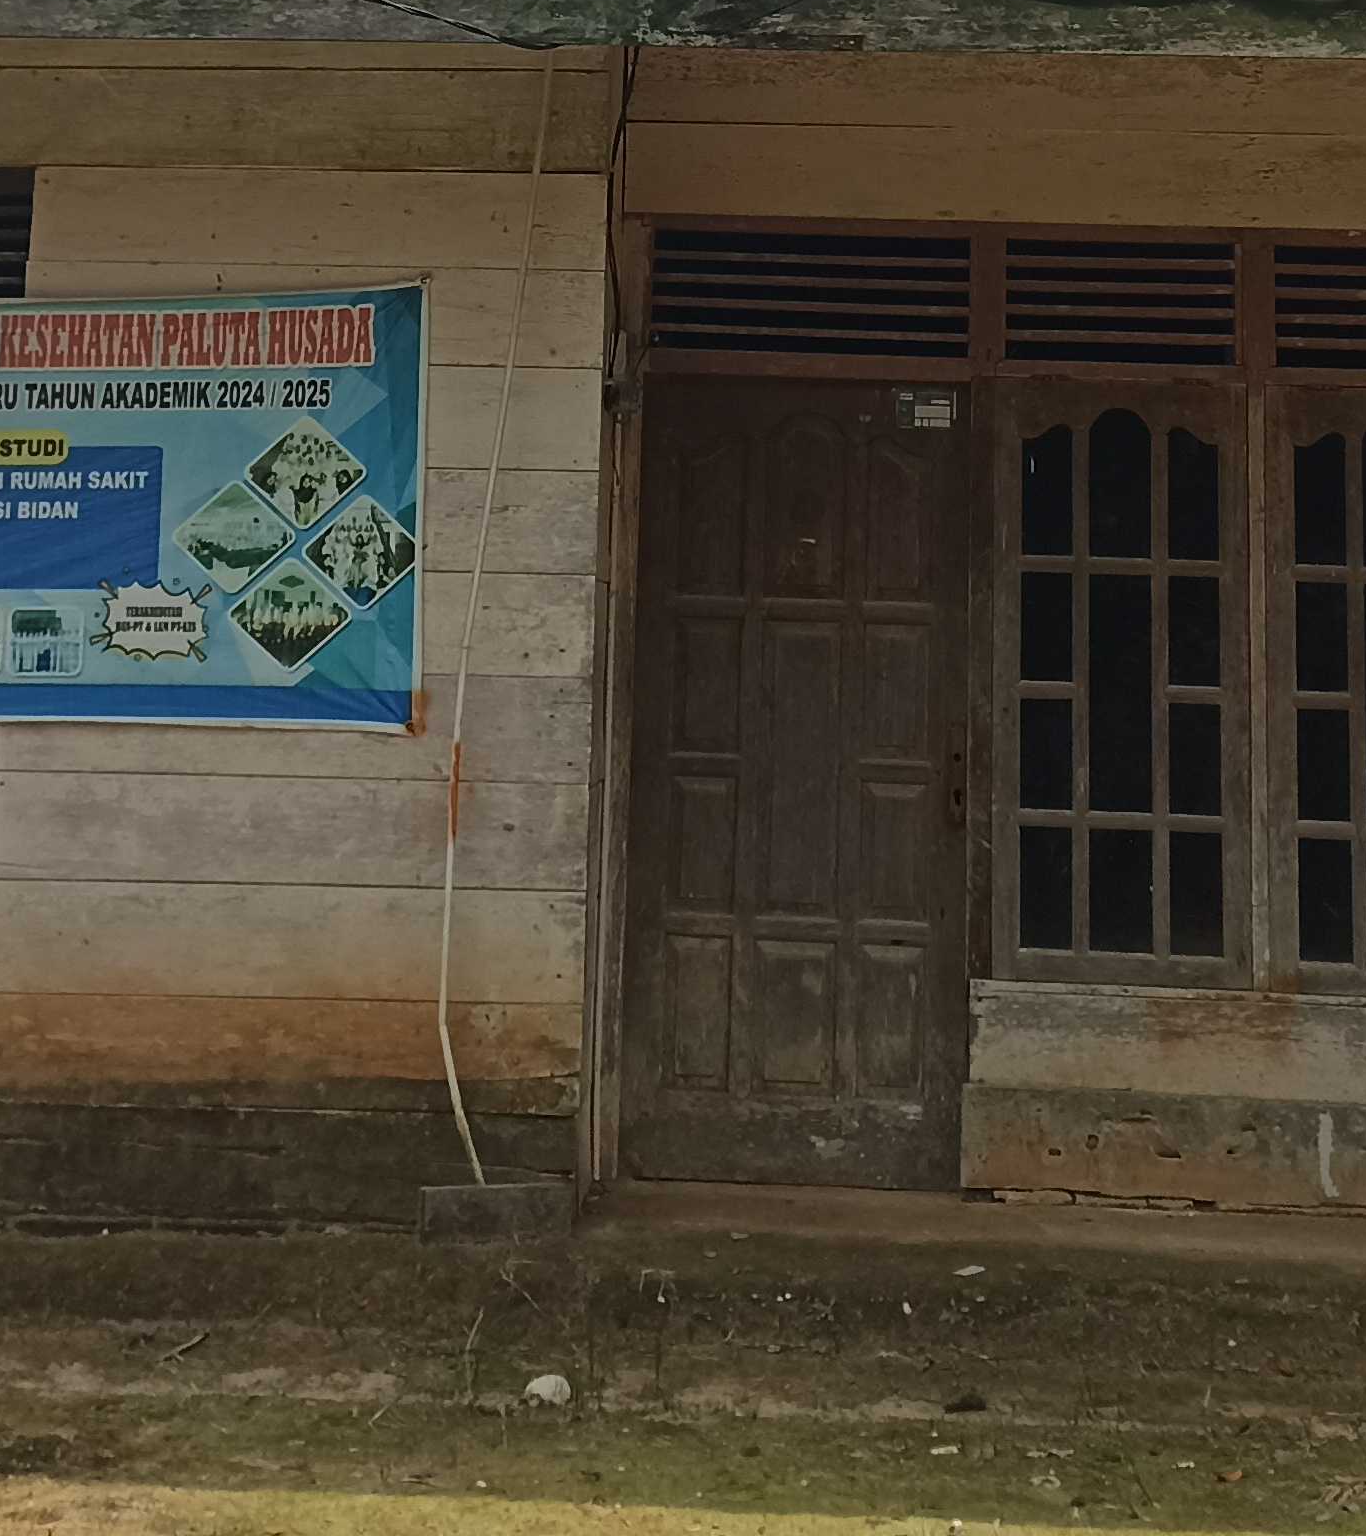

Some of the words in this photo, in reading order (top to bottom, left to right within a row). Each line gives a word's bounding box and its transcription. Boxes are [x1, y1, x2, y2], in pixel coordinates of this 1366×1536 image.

[160, 311, 261, 366] PALUTA
[266, 307, 372, 365] HUSADA
[25, 383, 95, 409] TAHUN
[101, 381, 211, 409] AKADEMIK
[217, 380, 265, 408] 2024
[282, 379, 330, 408] 2025
[0, 438, 64, 457] STUDI
[10, 472, 82, 489] RUMAH
[88, 471, 149, 489] SAKIT
[17, 502, 79, 519] BIDAN
